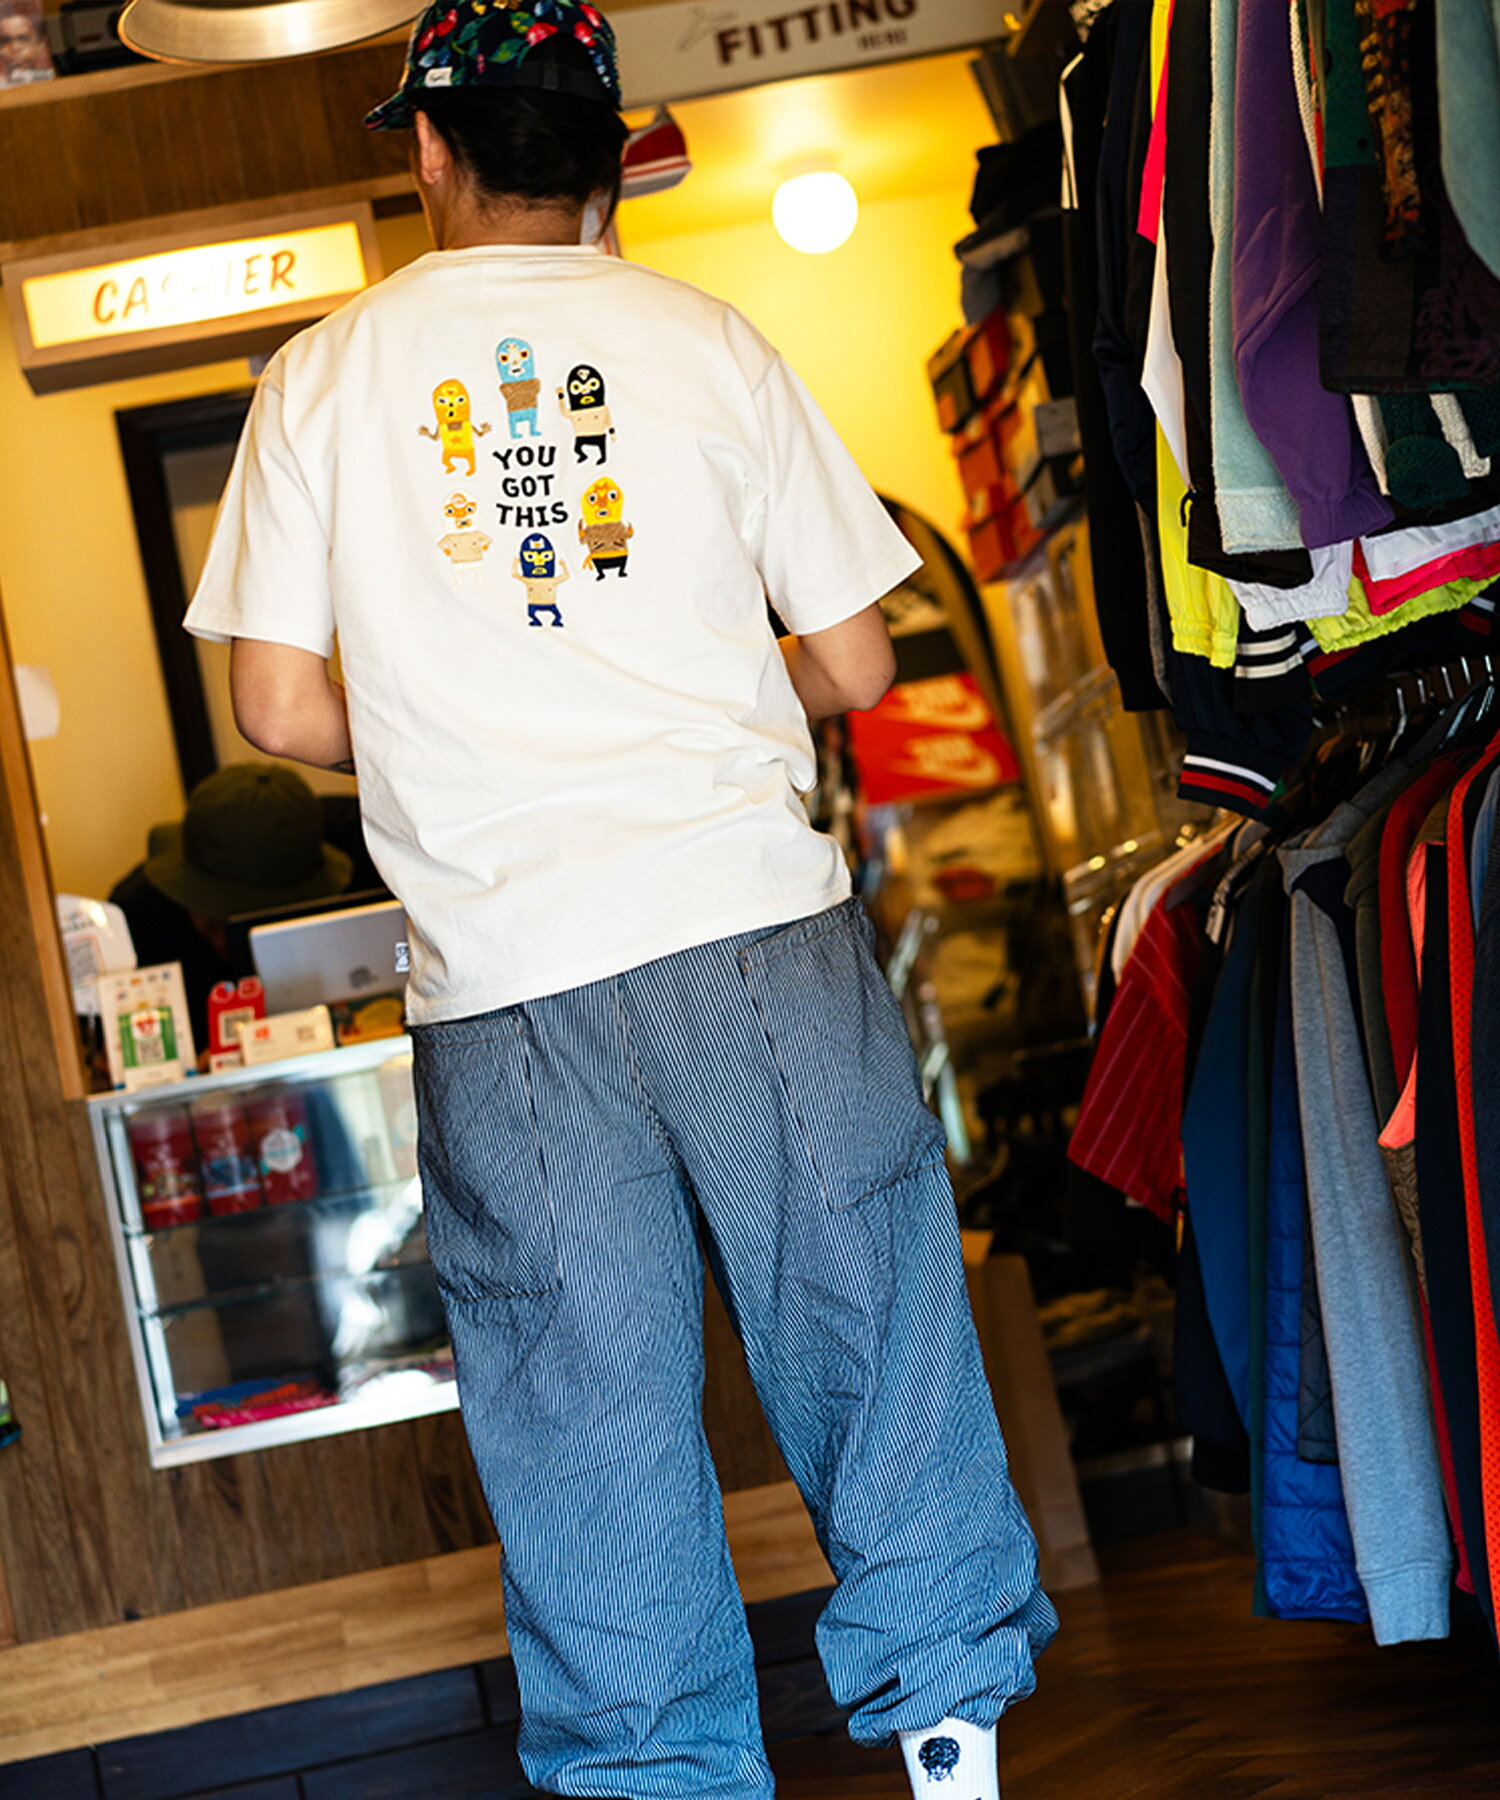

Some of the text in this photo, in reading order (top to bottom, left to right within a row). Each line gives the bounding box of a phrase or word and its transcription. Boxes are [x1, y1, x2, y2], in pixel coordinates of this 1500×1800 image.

[714, 0, 918, 66] FITTING
[492, 445, 556, 470] YOU
[502, 474, 555, 498] GOT
[496, 501, 569, 528] THIS
